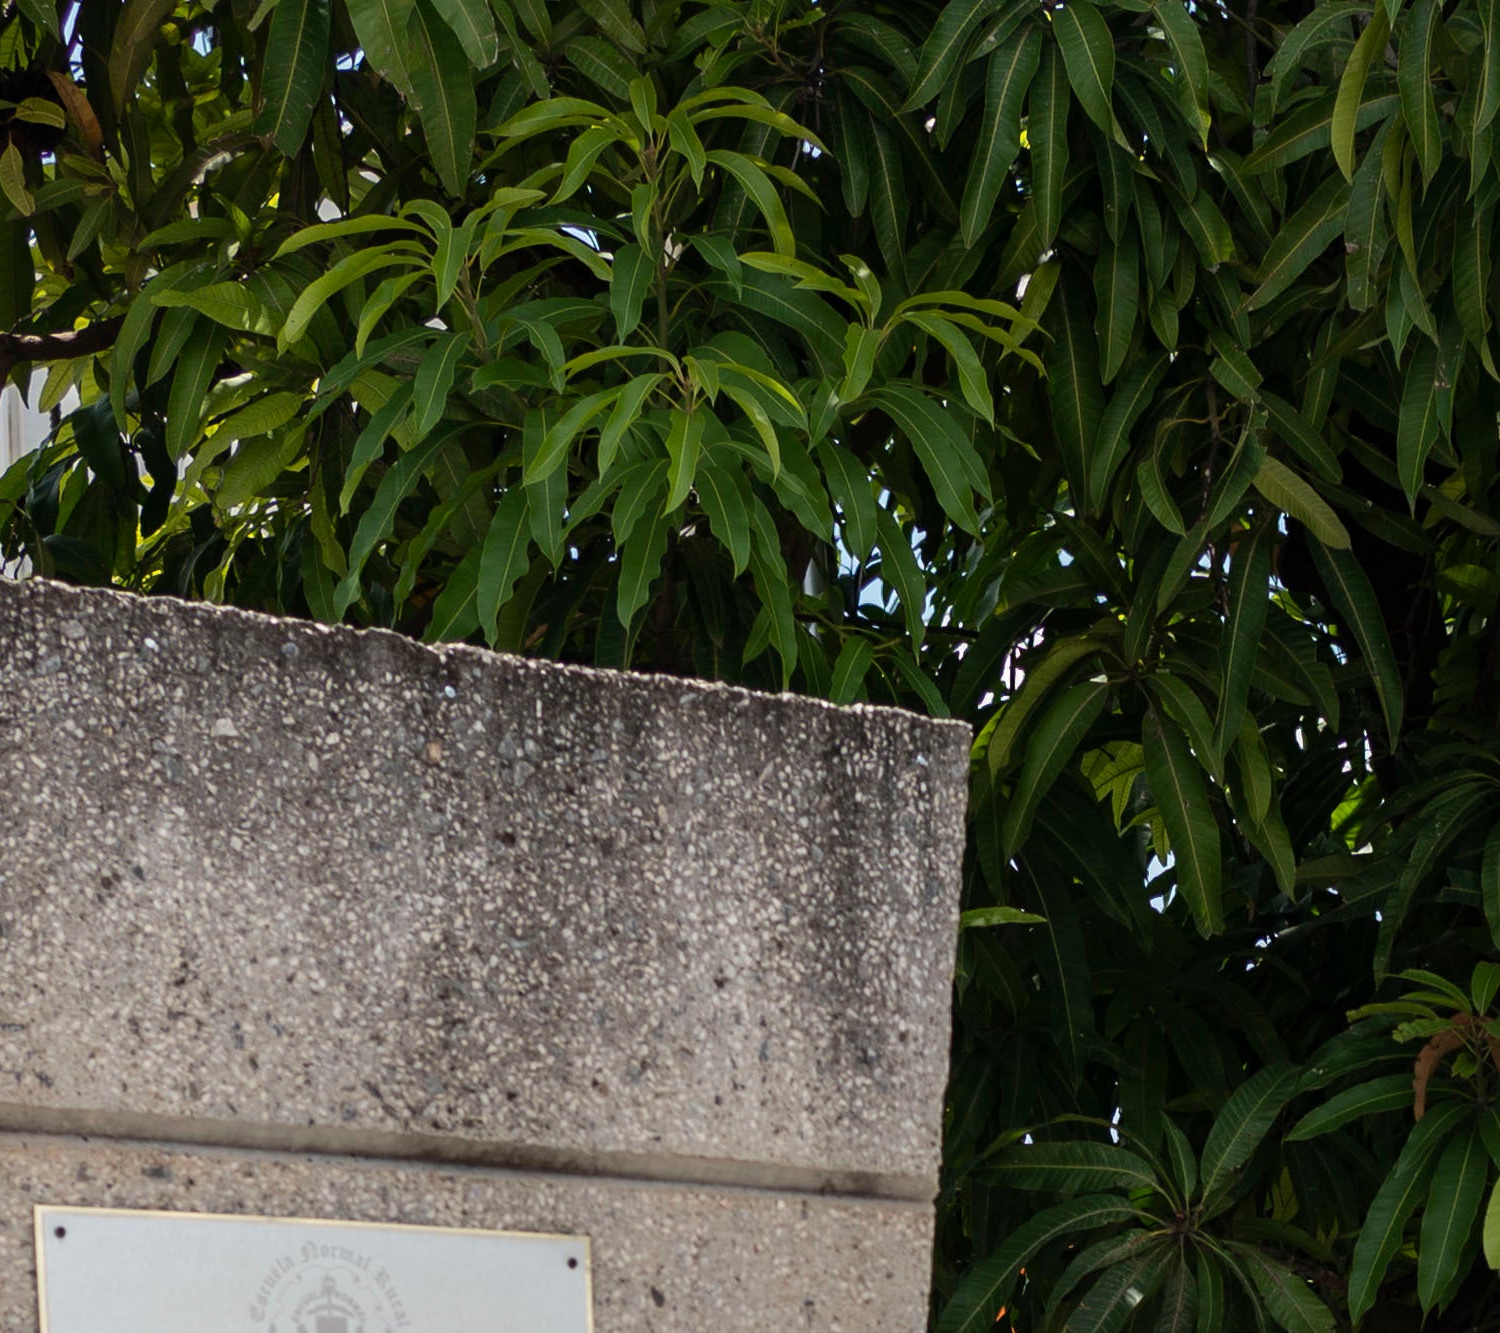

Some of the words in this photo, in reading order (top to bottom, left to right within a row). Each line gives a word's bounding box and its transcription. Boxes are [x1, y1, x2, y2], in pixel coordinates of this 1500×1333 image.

[248, 1255, 295, 1322] Escuela
[300, 1240, 372, 1272] Normal
[373, 1267, 412, 1327] Rural
